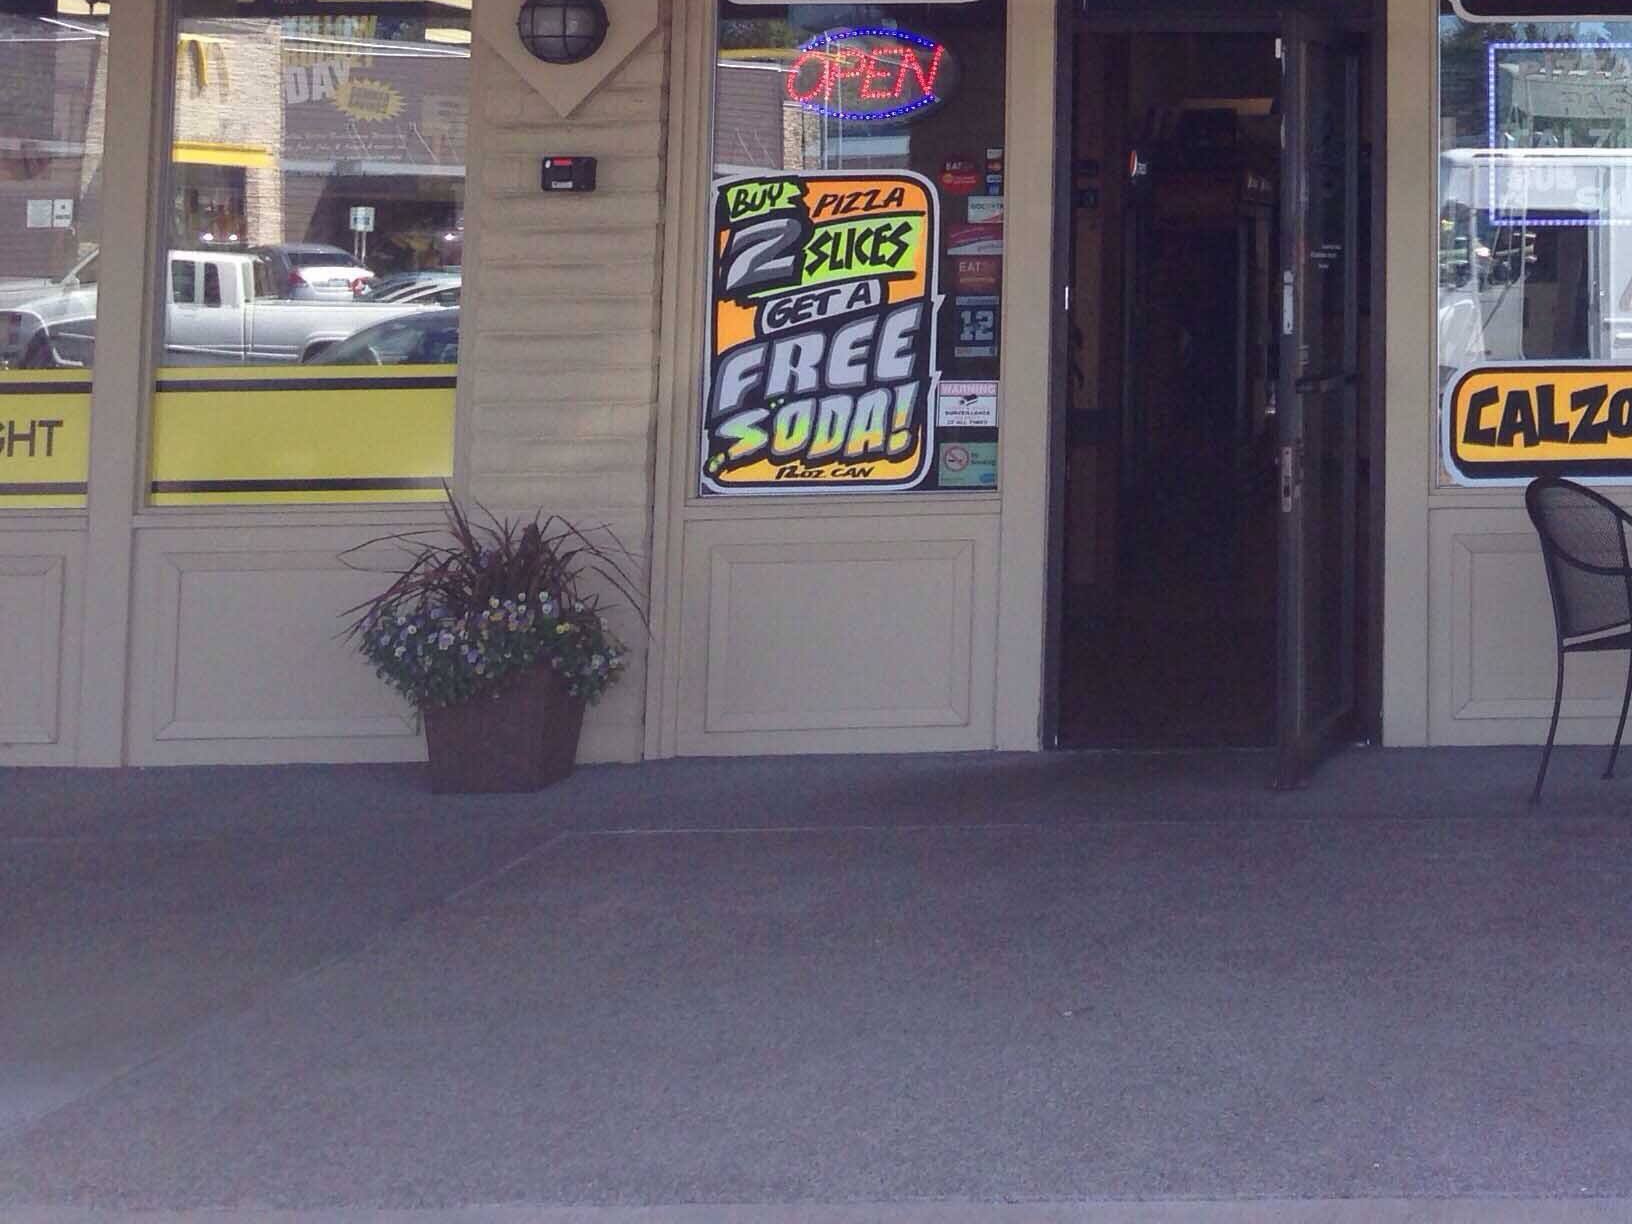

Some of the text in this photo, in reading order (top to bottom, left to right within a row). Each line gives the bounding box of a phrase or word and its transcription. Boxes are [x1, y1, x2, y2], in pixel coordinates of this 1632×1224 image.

[785, 44, 944, 101] OPEN
[730, 183, 905, 218] BUY PIZZA
[726, 218, 913, 291] 2 SLICES
[766, 282, 872, 328] GET A
[712, 302, 924, 418] FREE
[0, 419, 64, 457] HT
[714, 380, 920, 460] SODA!
[830, 466, 877, 478] CAN
